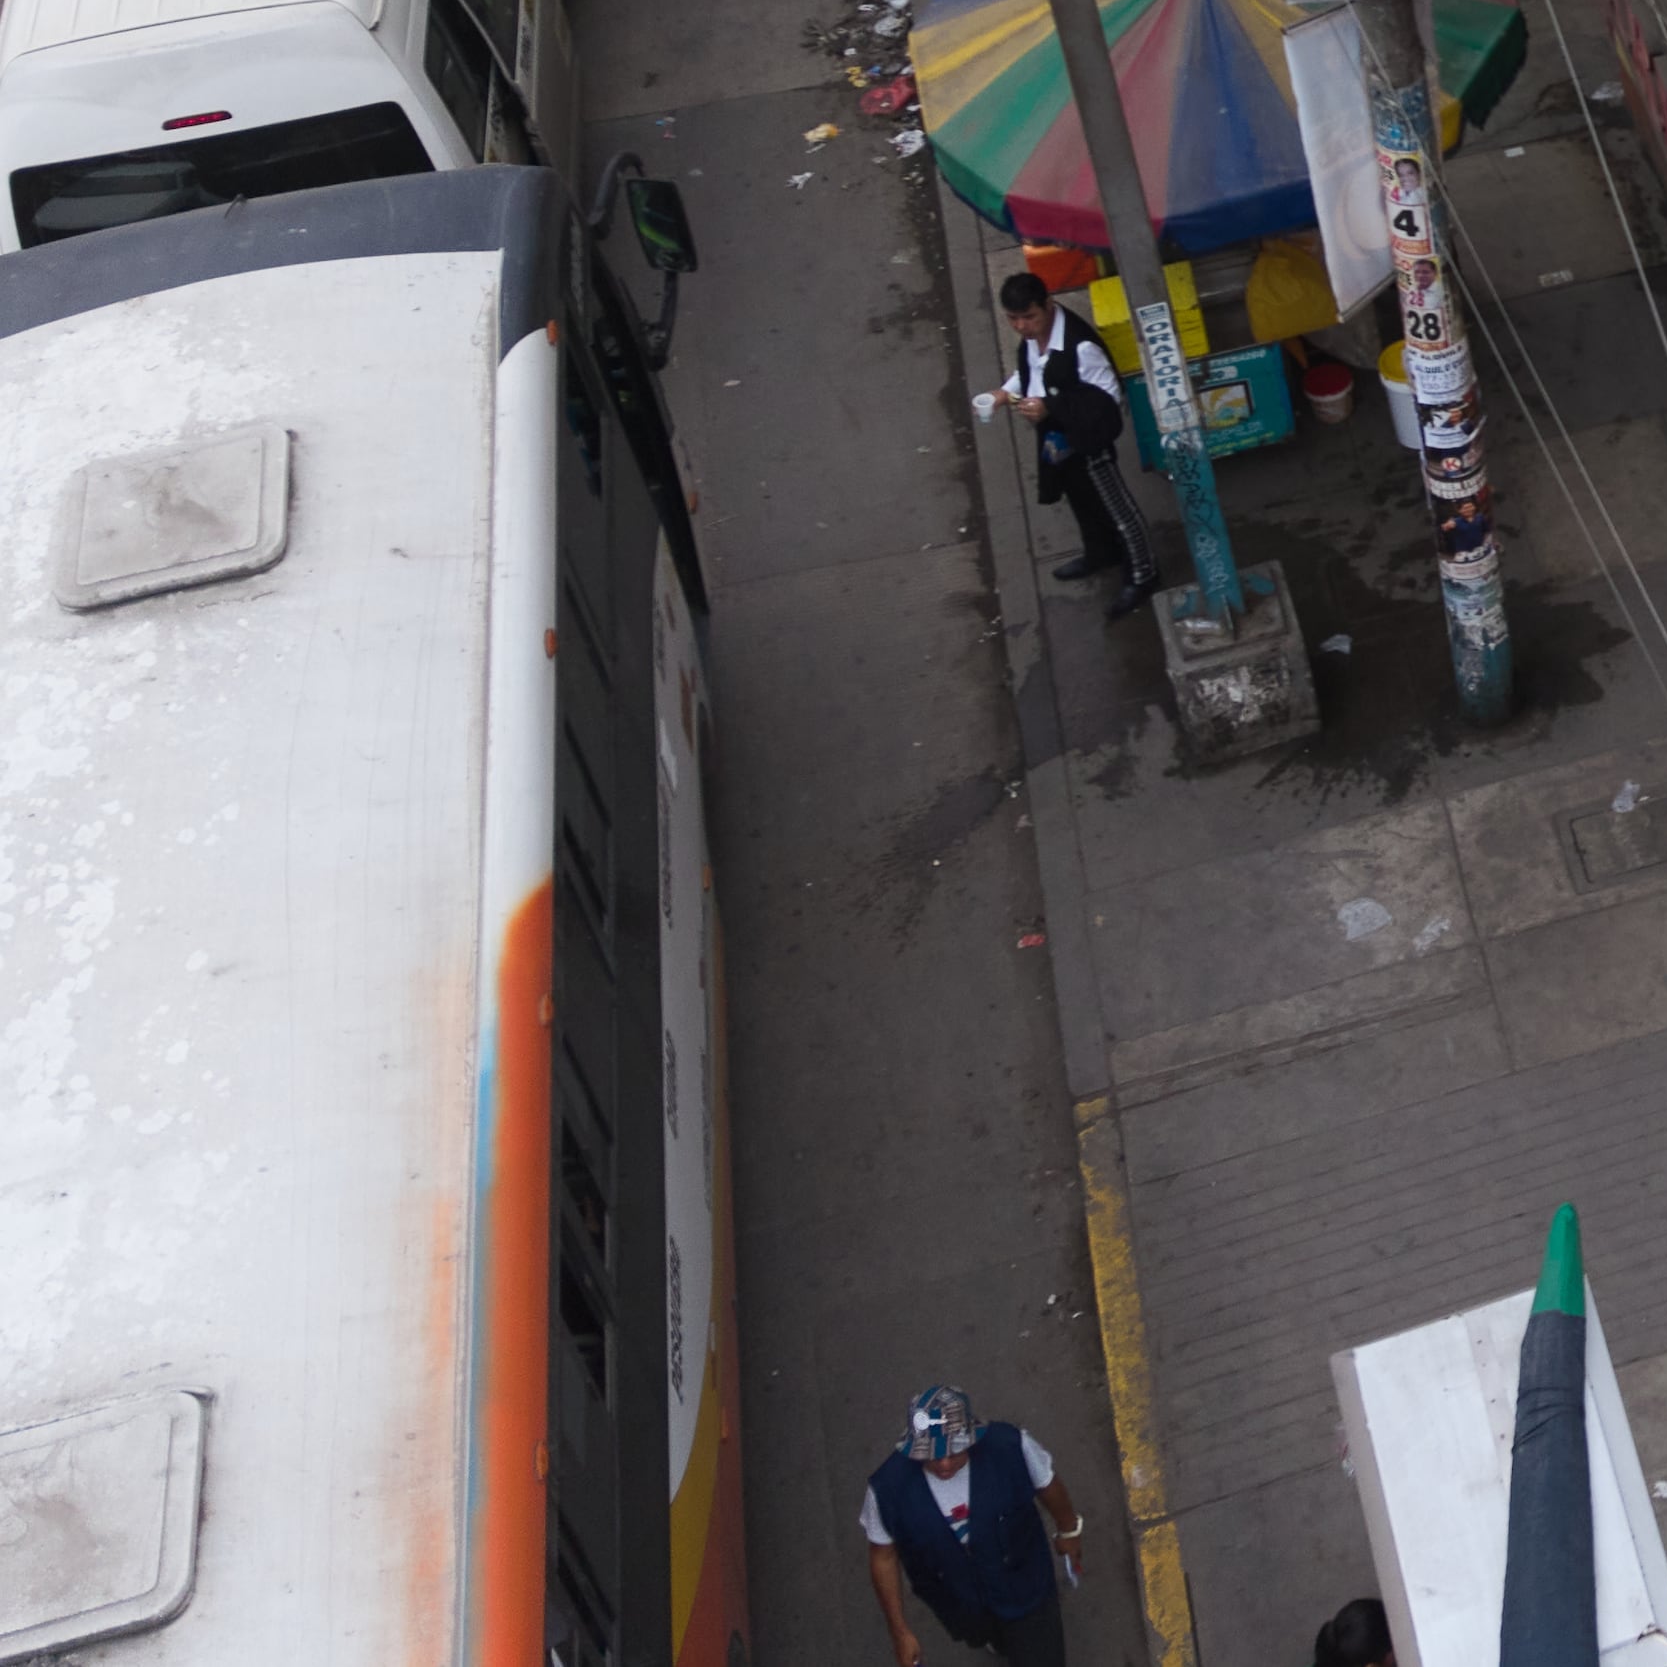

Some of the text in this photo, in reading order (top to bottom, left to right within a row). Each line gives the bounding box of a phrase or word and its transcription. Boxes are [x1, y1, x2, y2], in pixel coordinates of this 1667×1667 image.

[1394, 210, 1419, 237] 4
[1407, 310, 1441, 341] 28
[1144, 321, 1189, 410] ORATORIA
